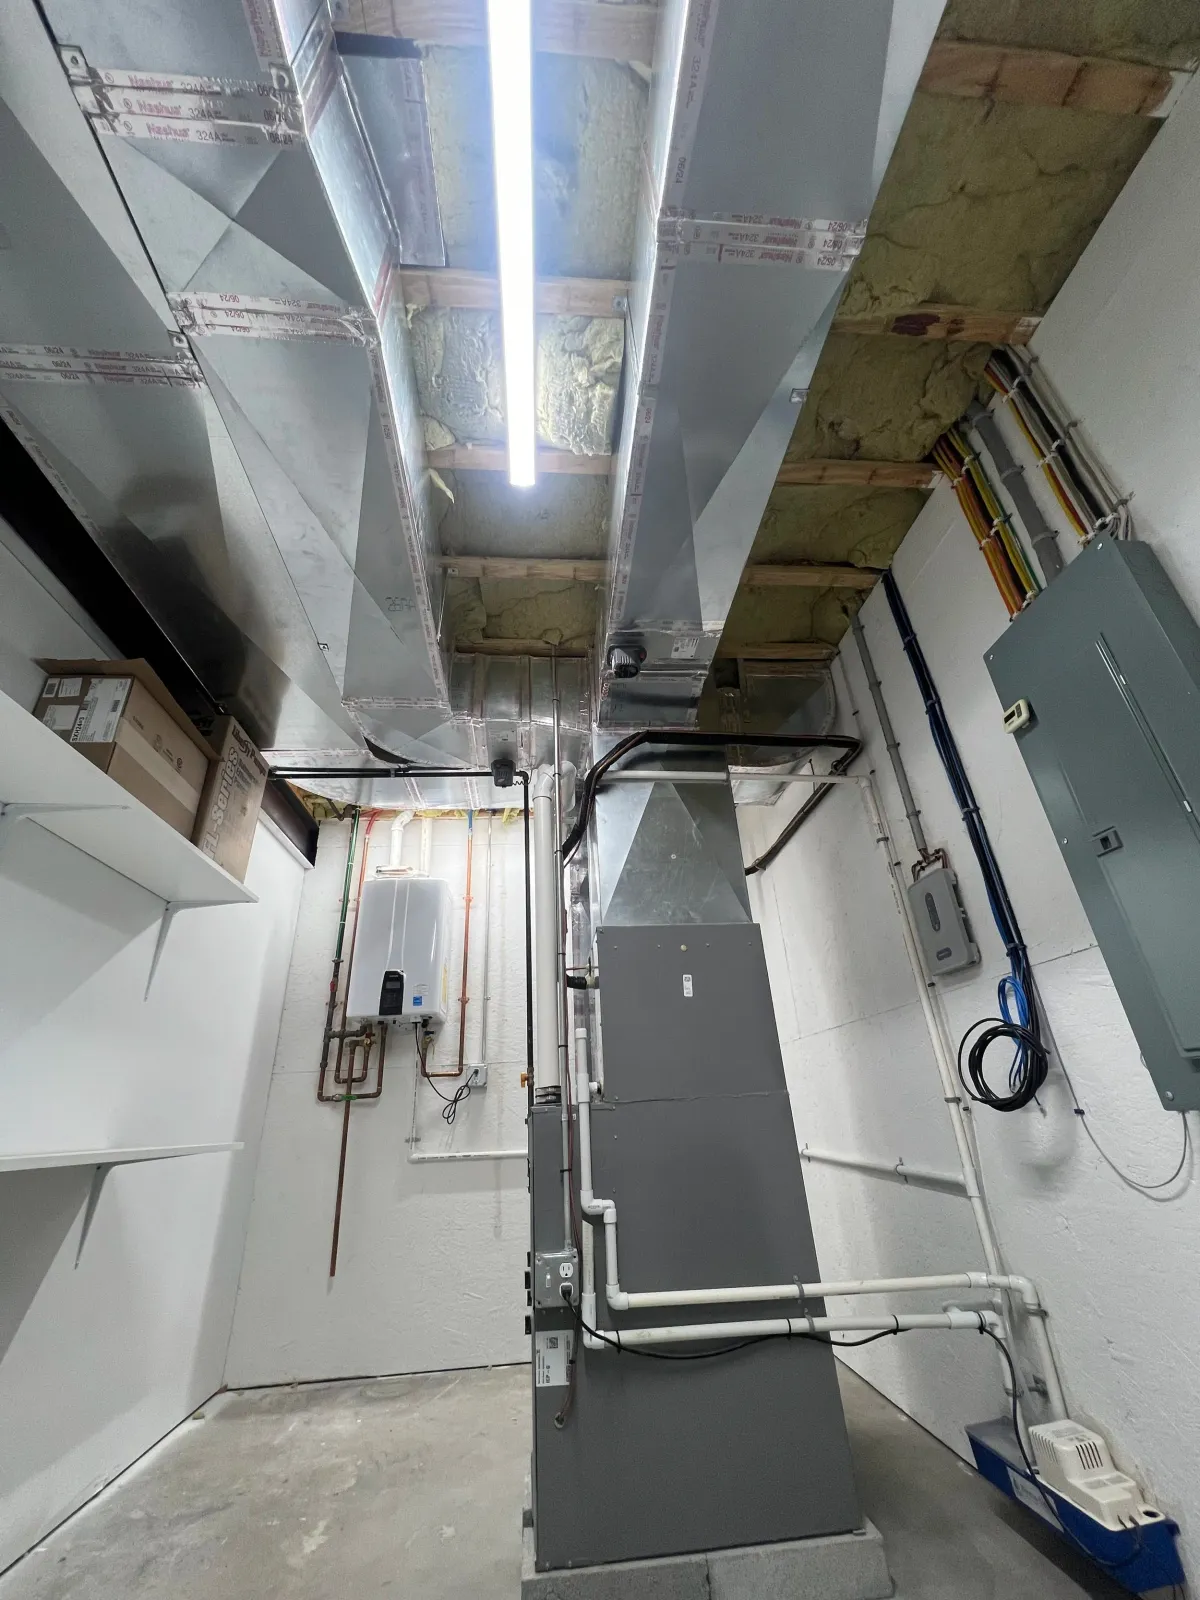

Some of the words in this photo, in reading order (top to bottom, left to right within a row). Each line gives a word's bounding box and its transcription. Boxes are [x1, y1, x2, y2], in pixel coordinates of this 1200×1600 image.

[196, 130, 223, 142] 324A
[219, 294, 240, 303] 06/24
[224, 310, 245, 319] 06/24
